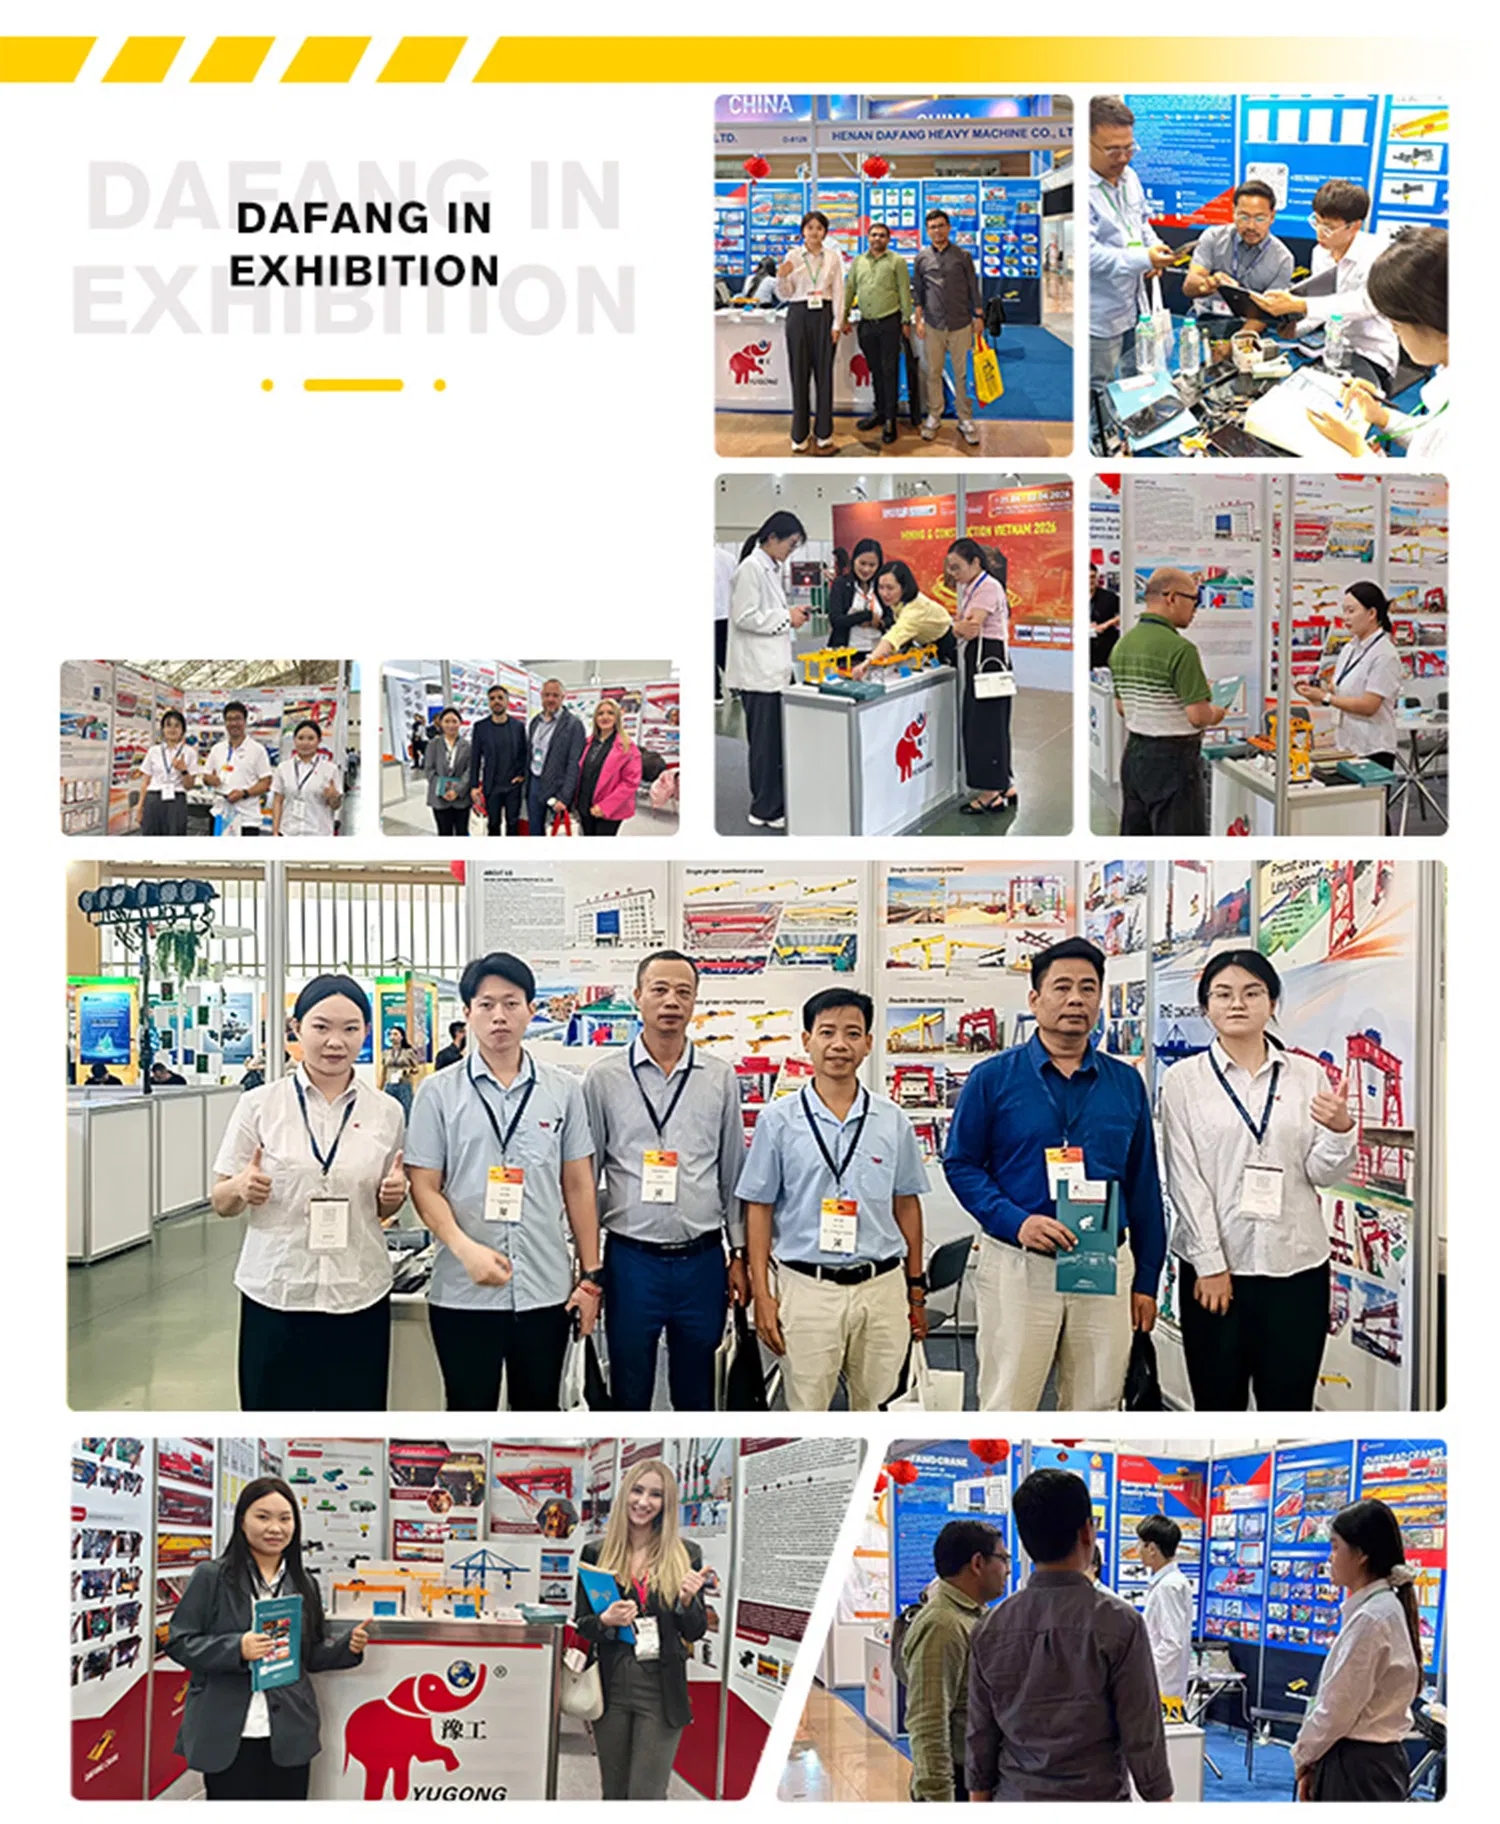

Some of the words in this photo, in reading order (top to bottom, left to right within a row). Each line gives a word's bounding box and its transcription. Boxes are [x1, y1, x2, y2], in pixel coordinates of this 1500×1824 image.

[728, 94, 794, 114] CHINA
[832, 131, 874, 142] HENAN
[876, 130, 926, 141] DAFANG
[928, 128, 970, 139] HEAVY
[972, 128, 1028, 139] MACHINE
[441, 1718, 487, 1740] 豫工
[413, 1786, 508, 1801] YUGONG
